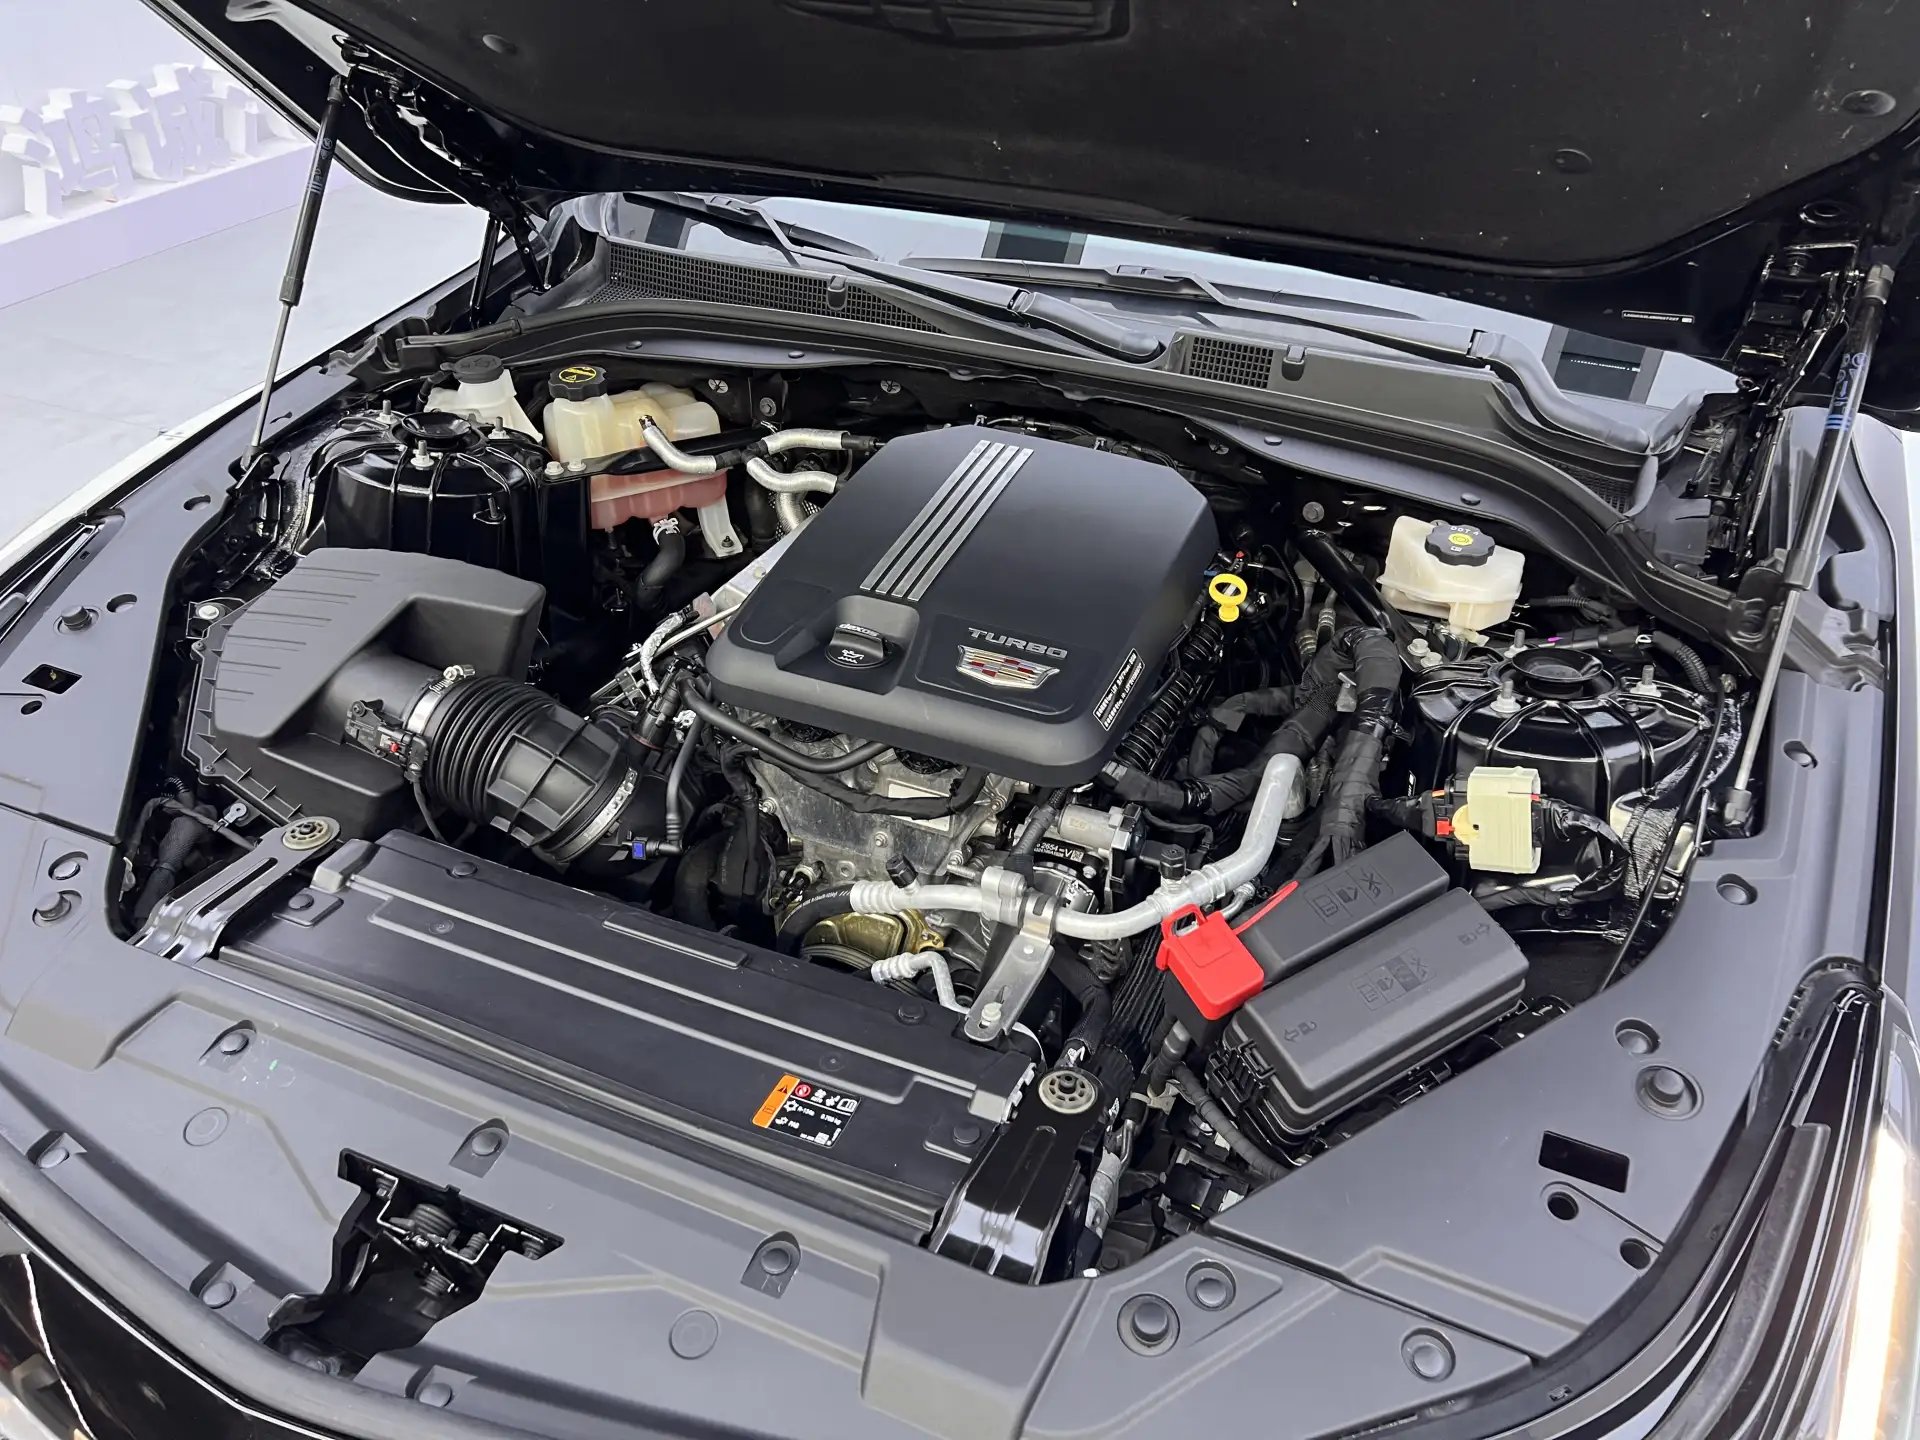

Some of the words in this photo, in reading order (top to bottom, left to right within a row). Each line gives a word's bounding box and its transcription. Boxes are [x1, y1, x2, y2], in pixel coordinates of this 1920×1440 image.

[1450, 525, 1471, 534] DOT
[839, 623, 879, 637] dexos
[968, 626, 1069, 660] TURBO
